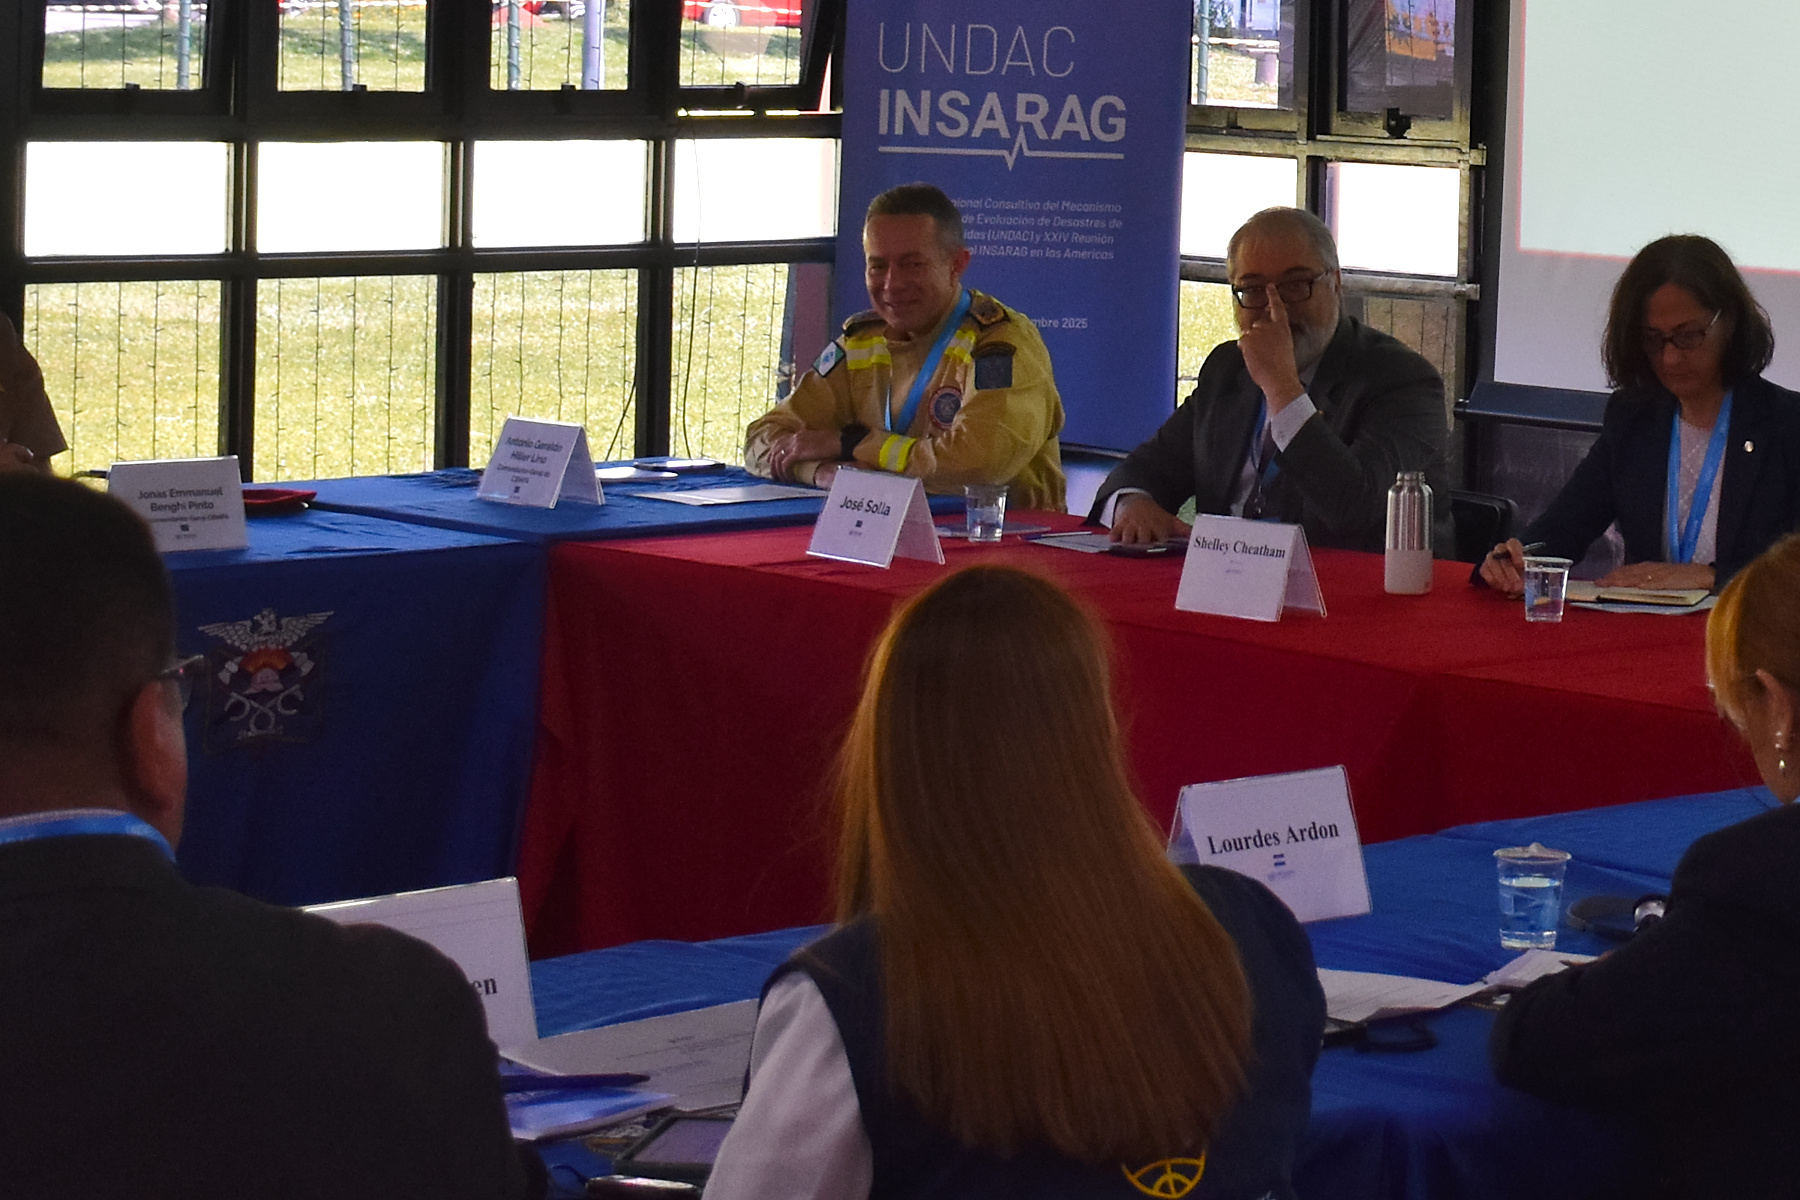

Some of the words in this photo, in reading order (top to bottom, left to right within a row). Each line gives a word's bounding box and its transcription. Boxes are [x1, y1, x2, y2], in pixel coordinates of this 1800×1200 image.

[878, 22, 1077, 78] UNDAC
[878, 89, 1127, 142] INSARAG
[951, 196, 983, 209] ional
[984, 198, 1041, 211] Consultivo
[1042, 200, 1060, 211] del
[1061, 200, 1122, 213] Mecanismo
[1037, 217, 1051, 226] de
[1053, 216, 1107, 228] Desastres
[1108, 218, 1123, 229] de
[1043, 231, 1069, 242] XXIV
[979, 245, 1028, 257] INSARAG
[1030, 249, 1043, 257] en
[1046, 247, 1061, 258] las
[1031, 317, 1060, 329] mbre
[1062, 318, 1088, 329] 2025
[138, 490, 168, 500] Jonas
[188, 500, 214, 510] Pinto
[840, 496, 864, 512] José
[1194, 536, 1231, 554] Shelley
[1233, 539, 1286, 559] Cheatham
[1207, 829, 1281, 855] Lourdes
[1286, 821, 1339, 844] Ardon
